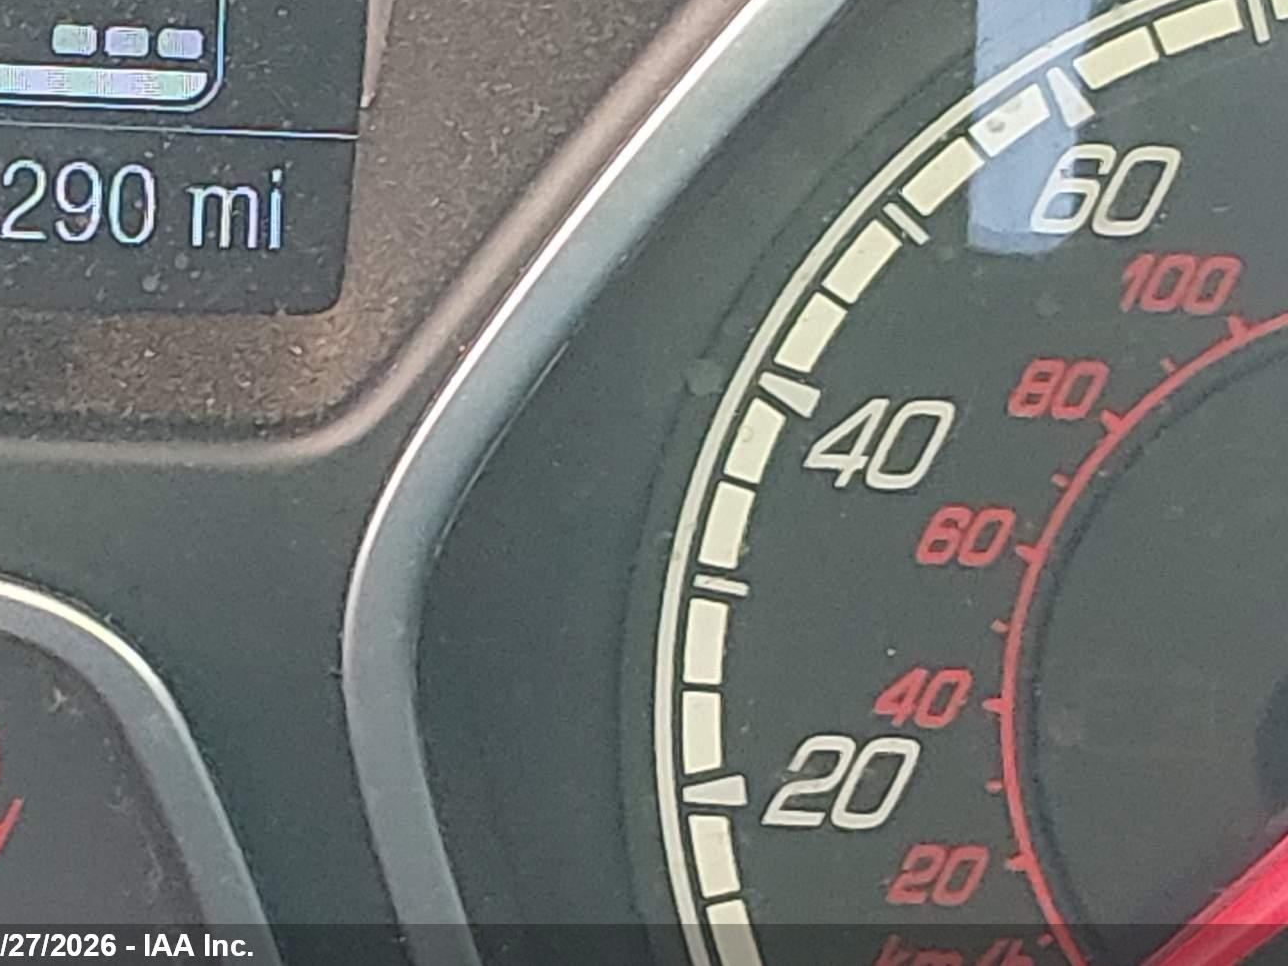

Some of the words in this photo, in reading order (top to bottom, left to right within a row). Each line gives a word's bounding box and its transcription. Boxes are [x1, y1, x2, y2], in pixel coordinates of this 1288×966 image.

[187, 168, 286, 251] mi
[1030, 144, 1181, 236] 60
[1120, 253, 1243, 315] 100
[1007, 358, 1109, 420] 80
[803, 397, 956, 490] 40
[915, 506, 1015, 566] 60
[873, 667, 974, 729] 40
[761, 734, 922, 830] 20
[885, 843, 989, 906] 20
